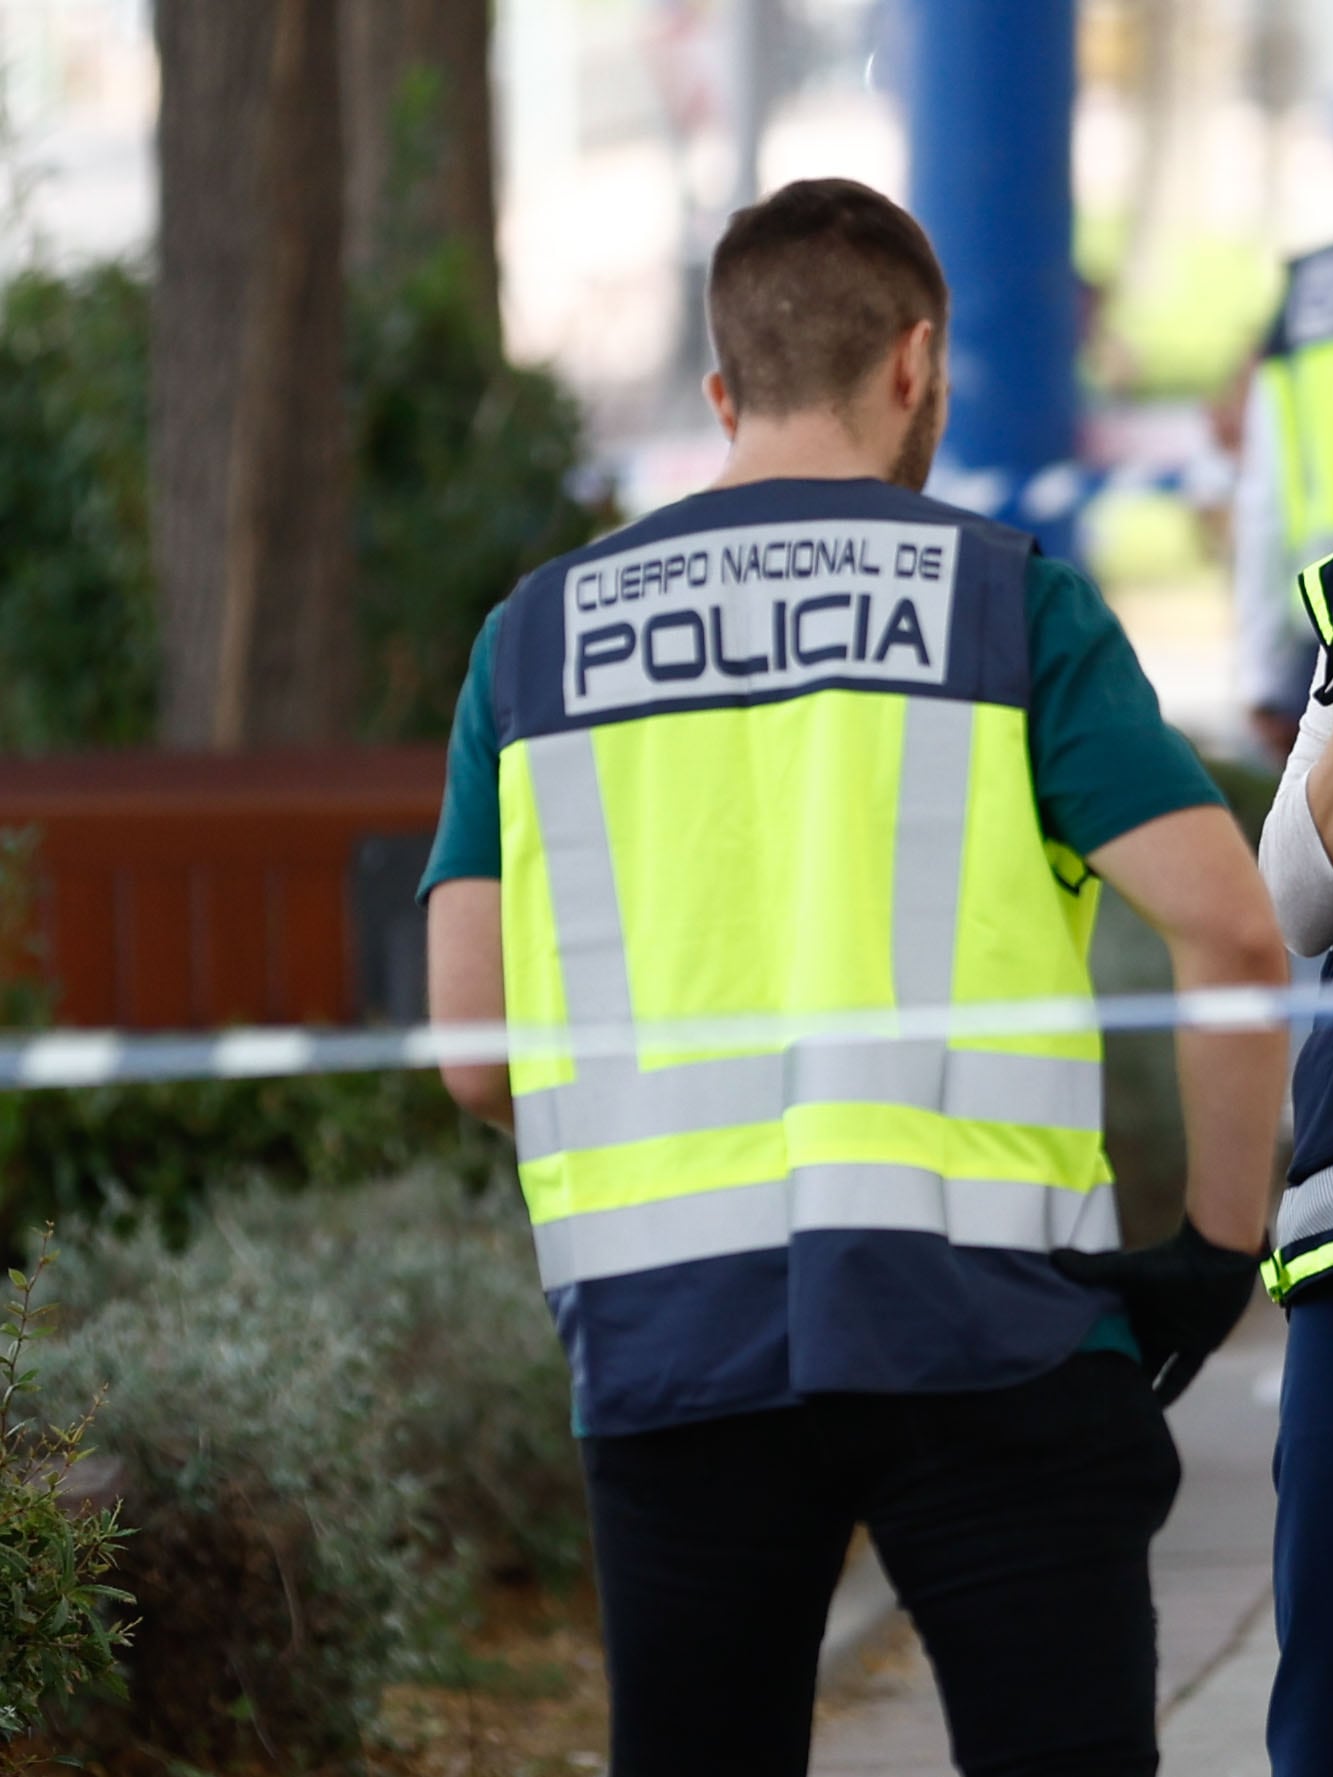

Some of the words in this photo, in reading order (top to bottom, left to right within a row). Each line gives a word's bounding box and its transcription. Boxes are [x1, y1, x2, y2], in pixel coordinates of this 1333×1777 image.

[575, 551, 709, 613] CUERPO
[721, 539, 881, 584] NACIONAL
[895, 542, 943, 581] DE
[575, 593, 931, 697] POLICIA
